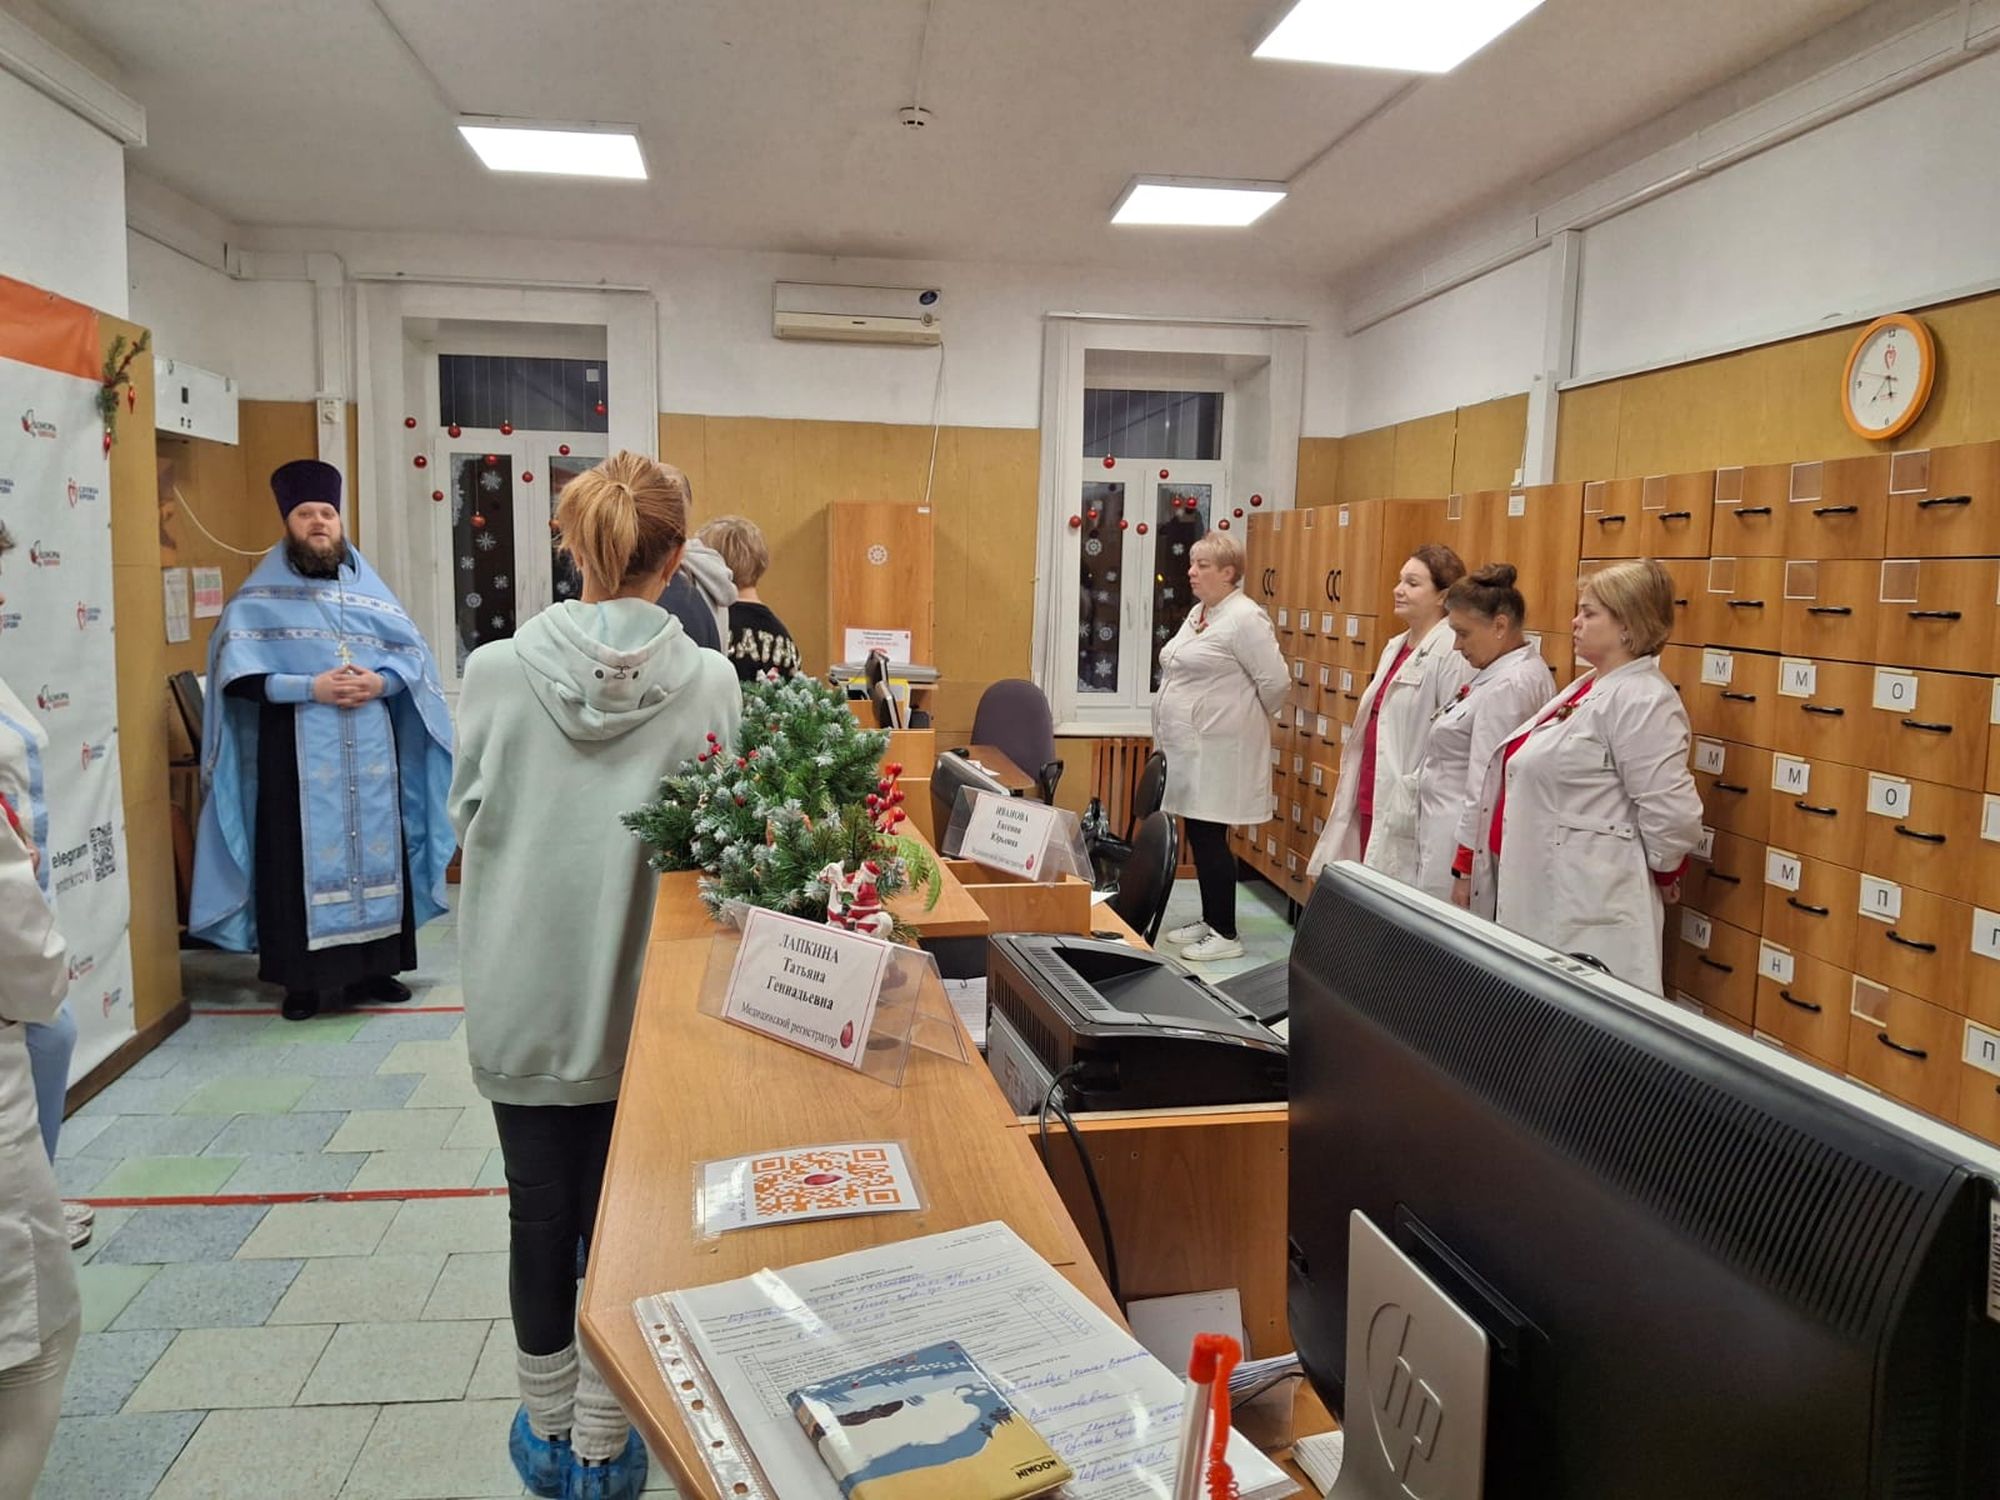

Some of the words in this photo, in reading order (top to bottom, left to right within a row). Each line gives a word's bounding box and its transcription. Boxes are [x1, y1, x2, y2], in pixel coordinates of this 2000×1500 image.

[1715, 660, 1726, 676] М
[1795, 669, 1808, 687] М
[1891, 682, 1904, 700] О
[1708, 750, 1719, 768] М
[1788, 767, 1801, 785] М
[1885, 788, 1897, 806] О
[1781, 863, 1794, 881] М
[1878, 889, 1888, 907] П
[1695, 923, 1706, 941] М
[779, 933, 839, 964] ЛАПКИНА
[783, 956, 827, 984] Татьяна
[1772, 956, 1781, 973] Н
[766, 975, 835, 1011] Геннадьевна
[741, 1000, 791, 1031] Медицинский
[790, 1021, 839, 1049] регистратор
[1983, 1040, 1996, 1062] П
[1014, 1458, 1059, 1481] MOOMIN
